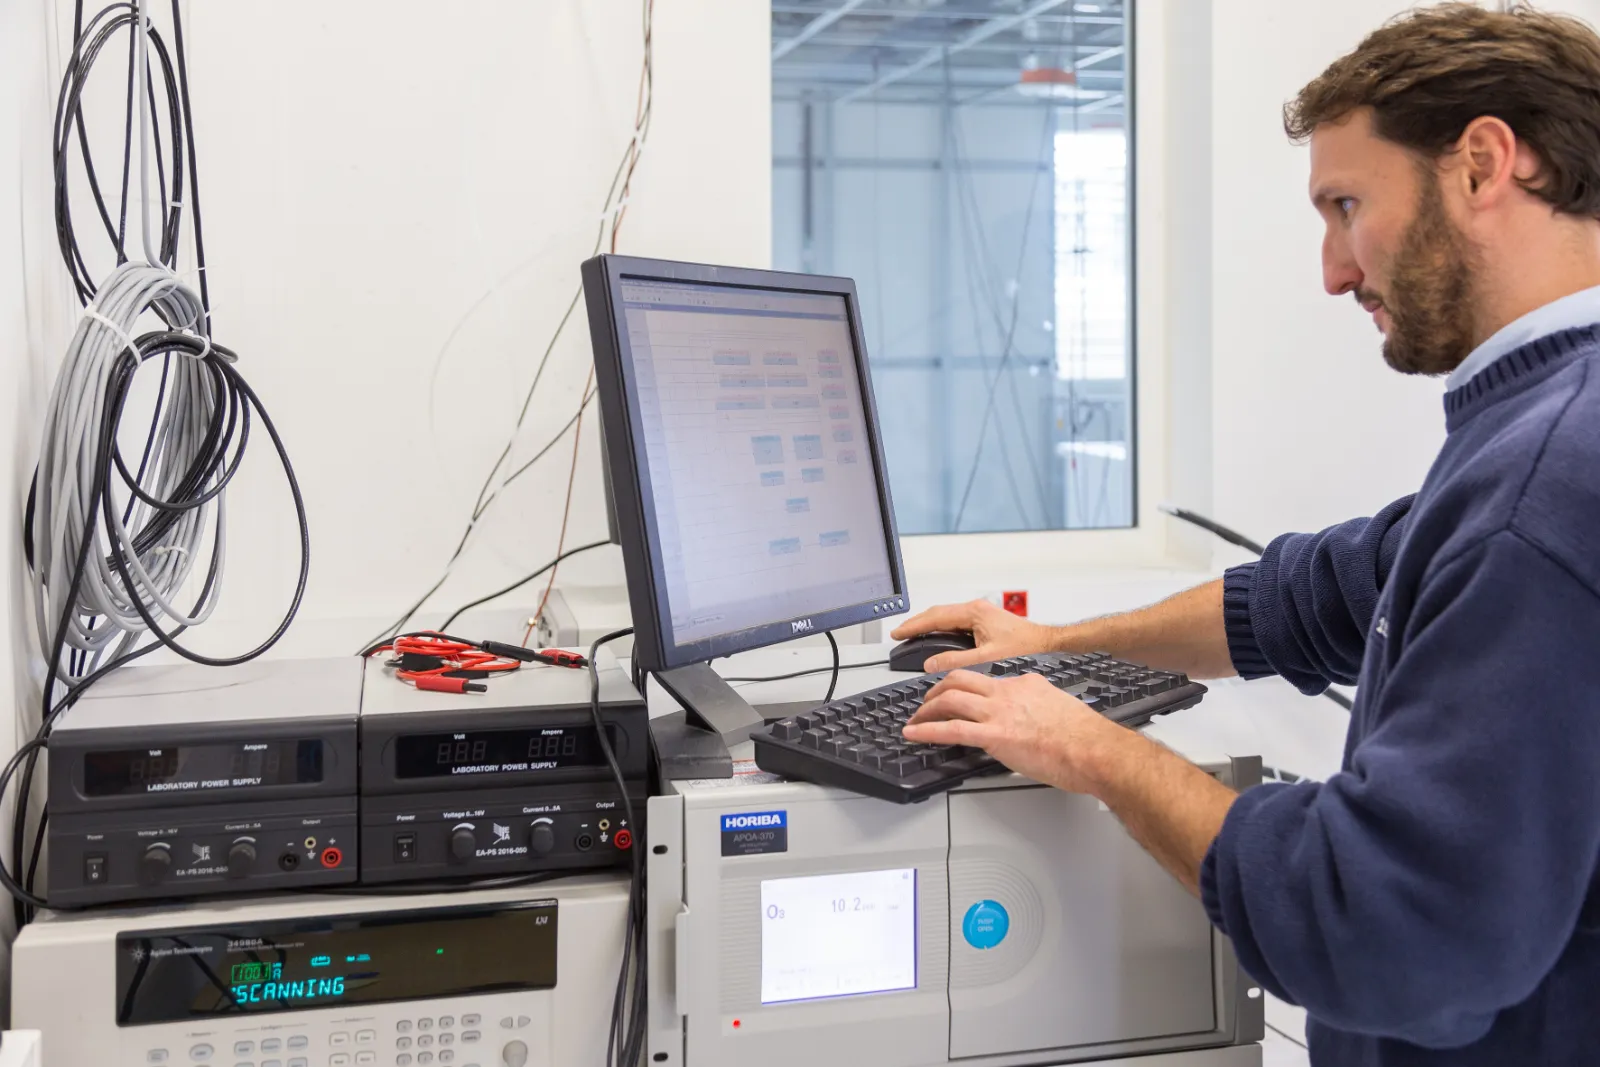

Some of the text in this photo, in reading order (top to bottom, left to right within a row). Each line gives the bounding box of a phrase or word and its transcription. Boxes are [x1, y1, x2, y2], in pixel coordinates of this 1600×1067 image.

[790, 618, 814, 634] DELL
[451, 761, 558, 774] LABORATORY POWER SUPPLY
[147, 777, 262, 792] LABORATORY POWER SUPPLY
[725, 814, 781, 828] HORIBA
[236, 976, 345, 1003] SCANNING
